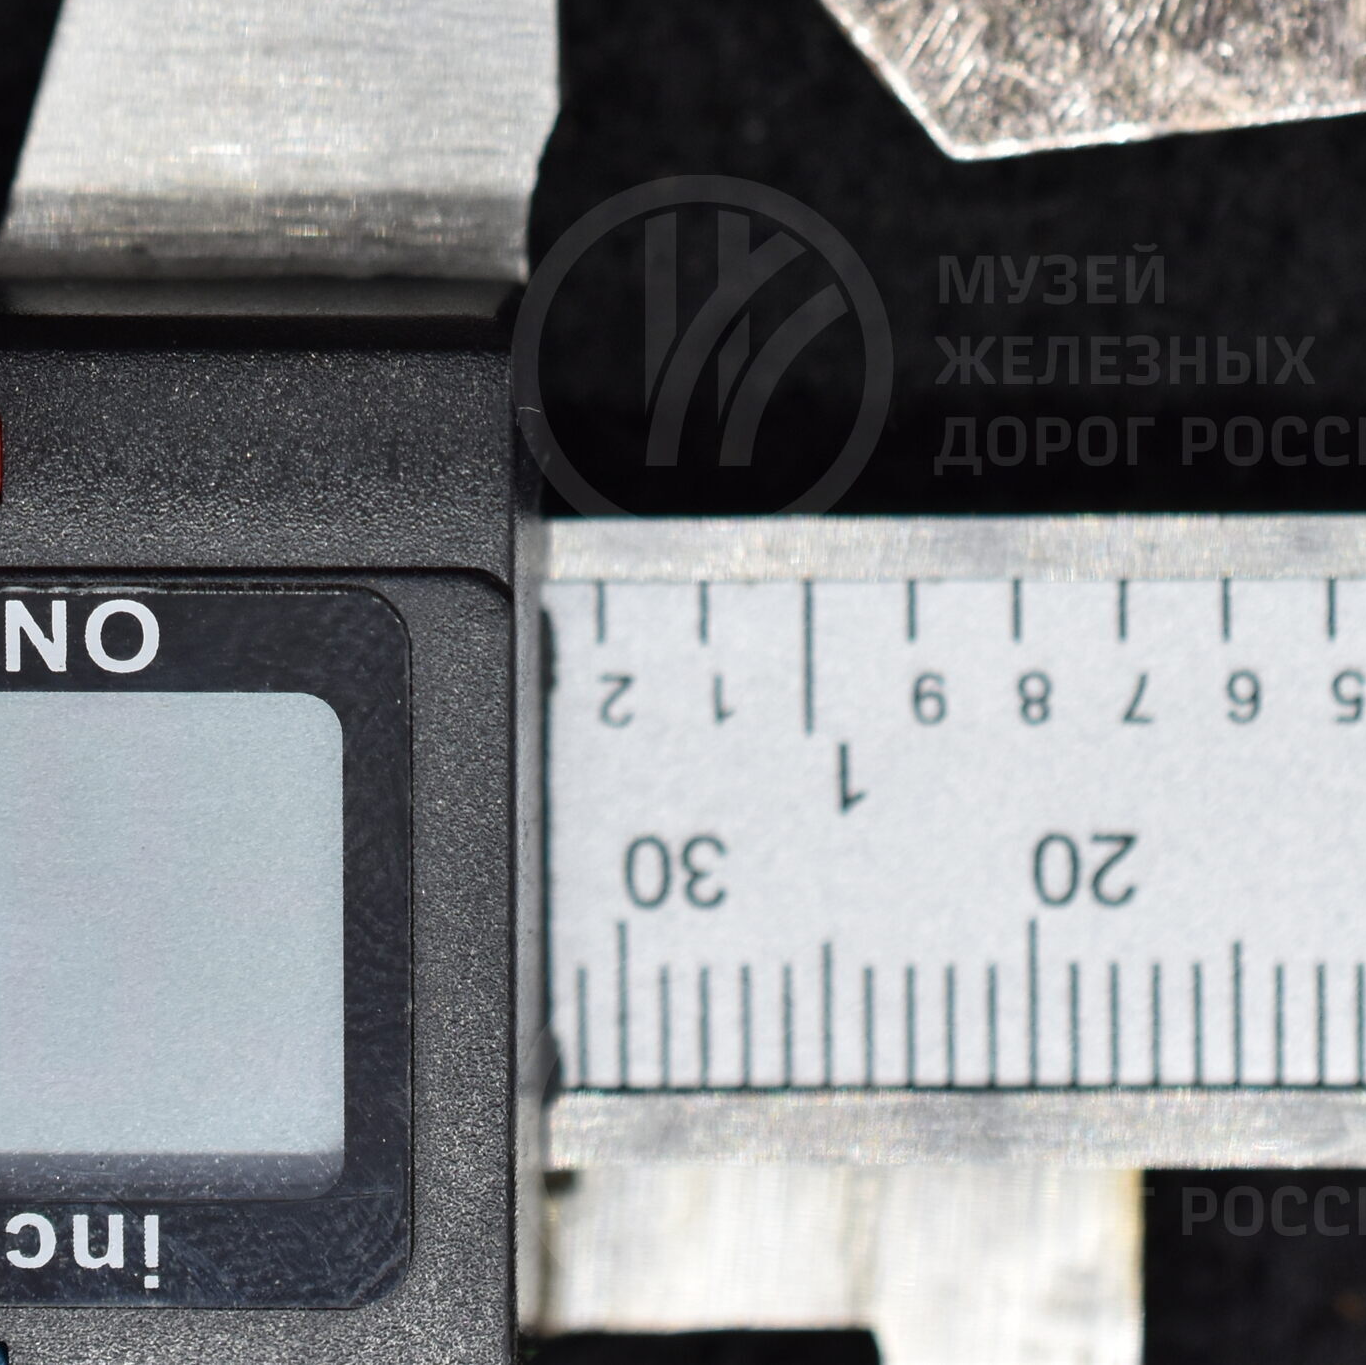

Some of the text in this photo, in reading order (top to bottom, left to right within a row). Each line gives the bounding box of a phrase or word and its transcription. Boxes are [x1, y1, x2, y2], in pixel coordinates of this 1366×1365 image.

[598, 672, 635, 726] 2
[711, 672, 734, 726] 1
[910, 671, 948, 725] 9
[1015, 671, 1053, 725] 8
[1120, 670, 1153, 724] 7
[1224, 670, 1263, 724] 6
[1330, 669, 1366, 724] 5
[836, 742, 866, 814] 1
[622, 832, 727, 911] 30
[1031, 831, 1139, 909] 20
